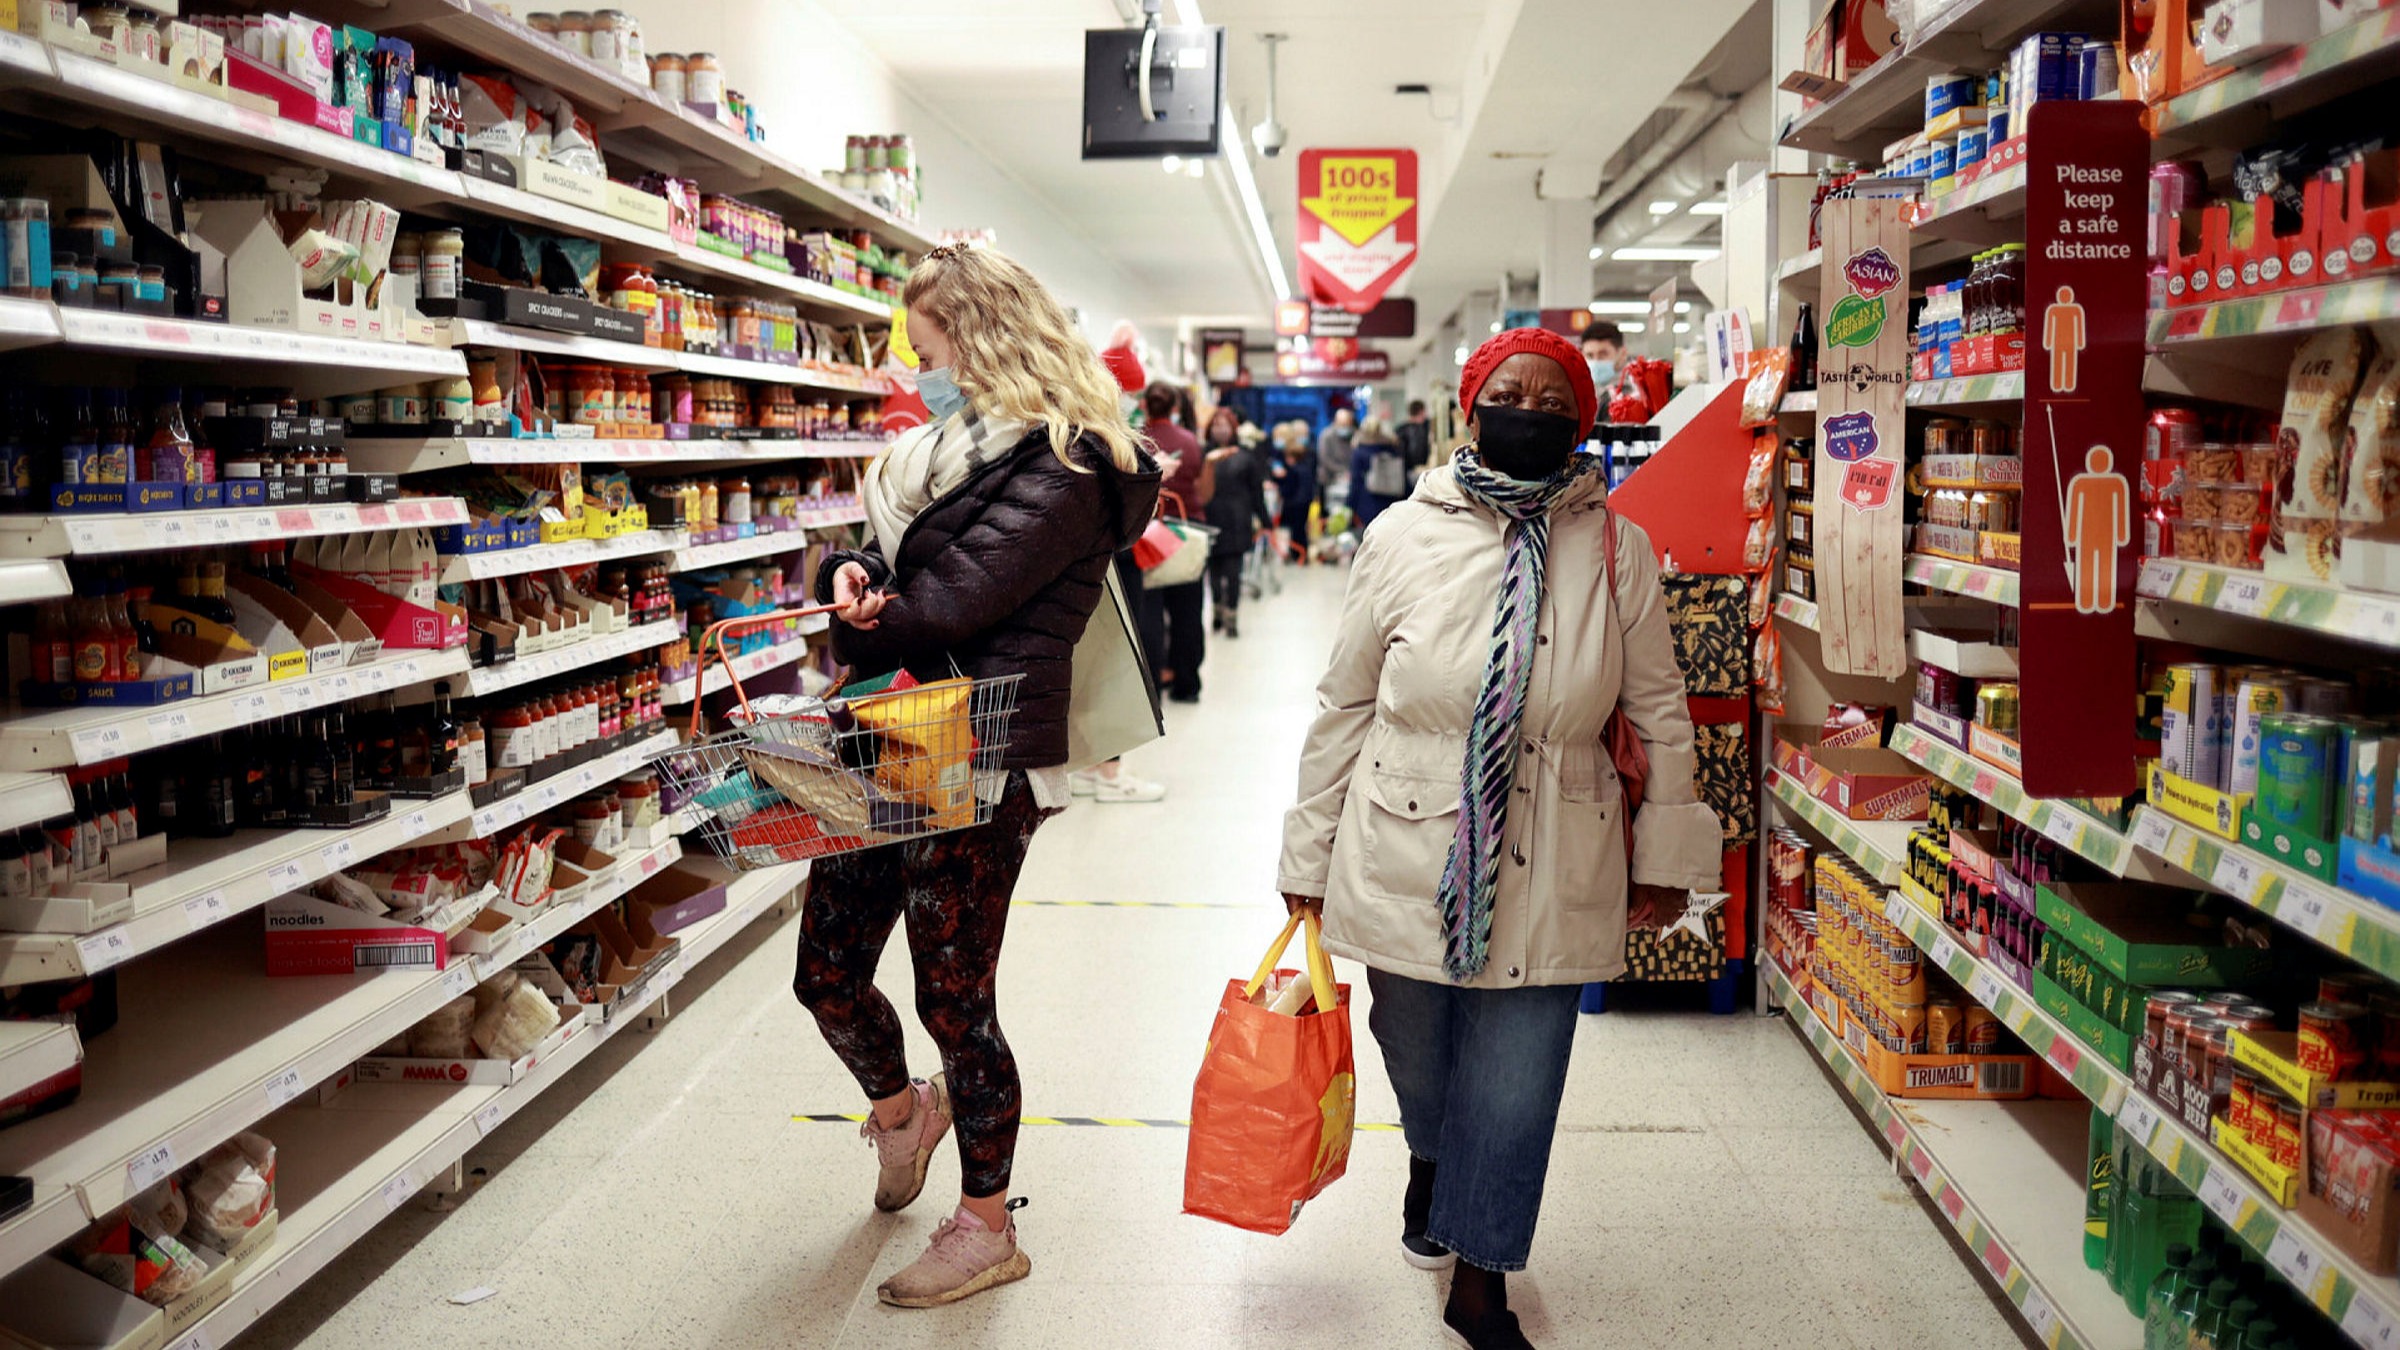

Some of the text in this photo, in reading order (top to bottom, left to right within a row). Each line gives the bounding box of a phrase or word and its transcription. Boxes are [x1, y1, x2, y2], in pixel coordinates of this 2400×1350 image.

[1328, 167, 1391, 188] 100s
[2056, 164, 2123, 183] Please
[2064, 188, 2114, 213] keep
[2059, 214, 2119, 233] a safe
[2045, 240, 2131, 259] distance
[1851, 263, 1895, 283] ASIAN
[1830, 311, 1882, 345] CARIBBEAN
[1831, 308, 1870, 336] AFRICAN
[1820, 372, 1903, 384] TASTES WORLD
[270, 421, 289, 430] CURRY
[1830, 426, 1870, 440] AMERICAN
[271, 430, 288, 440] PASTE
[269, 482, 285, 491] CURRY
[314, 477, 330, 487] CURRY
[315, 486, 328, 496] PASTE
[269, 490, 285, 500] PASTE
[228, 664, 253, 676] KIKKOMAN
[279, 657, 304, 669] KIKKOMAN
[1822, 720, 1880, 748] SUPERMALT
[1865, 779, 1931, 817] SUPERMALT
[269, 913, 325, 927] noodles
[403, 1065, 446, 1080] MAMA
[1911, 1065, 1970, 1087] TRUMALT
[2183, 1079, 2210, 1114] ROOT
[2184, 1101, 2208, 1136] BEER
[152, 1147, 169, 1165] £1.75
